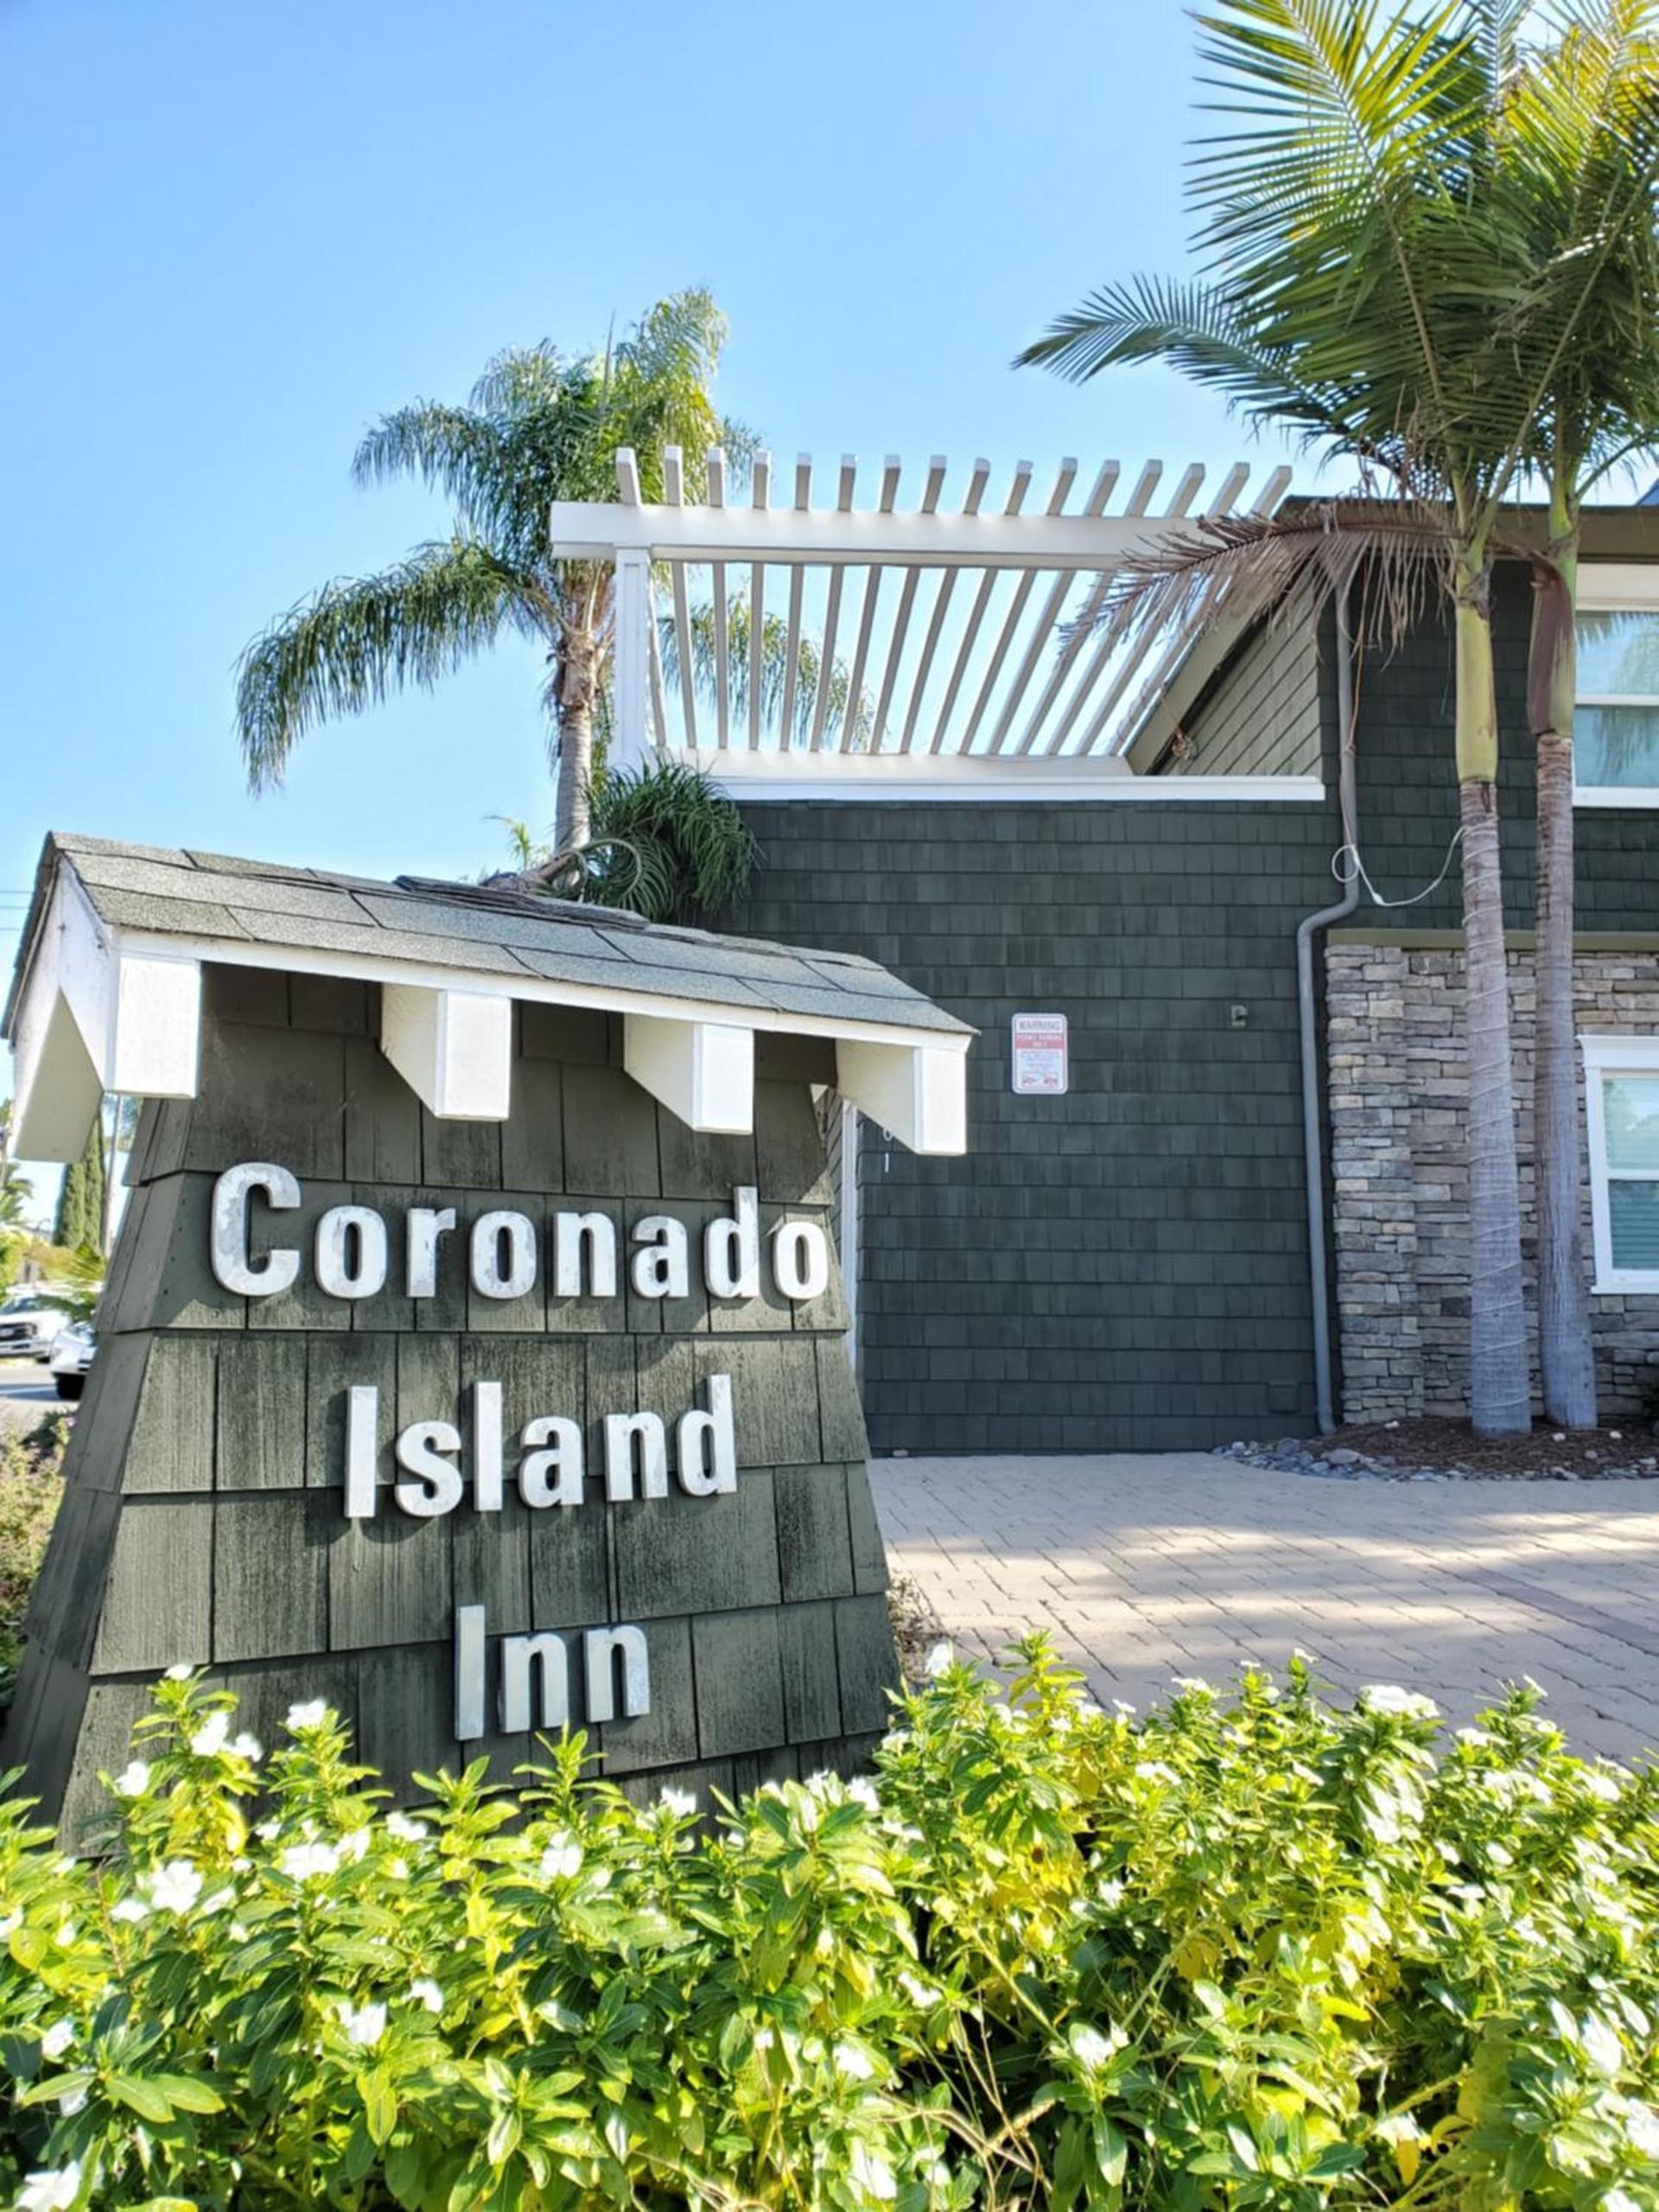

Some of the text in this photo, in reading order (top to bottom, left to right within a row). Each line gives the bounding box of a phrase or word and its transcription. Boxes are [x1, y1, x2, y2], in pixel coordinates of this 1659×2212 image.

[209, 1161, 830, 1300] Coronado
[344, 1373, 738, 1519] Island
[454, 1605, 651, 1741] Inn
